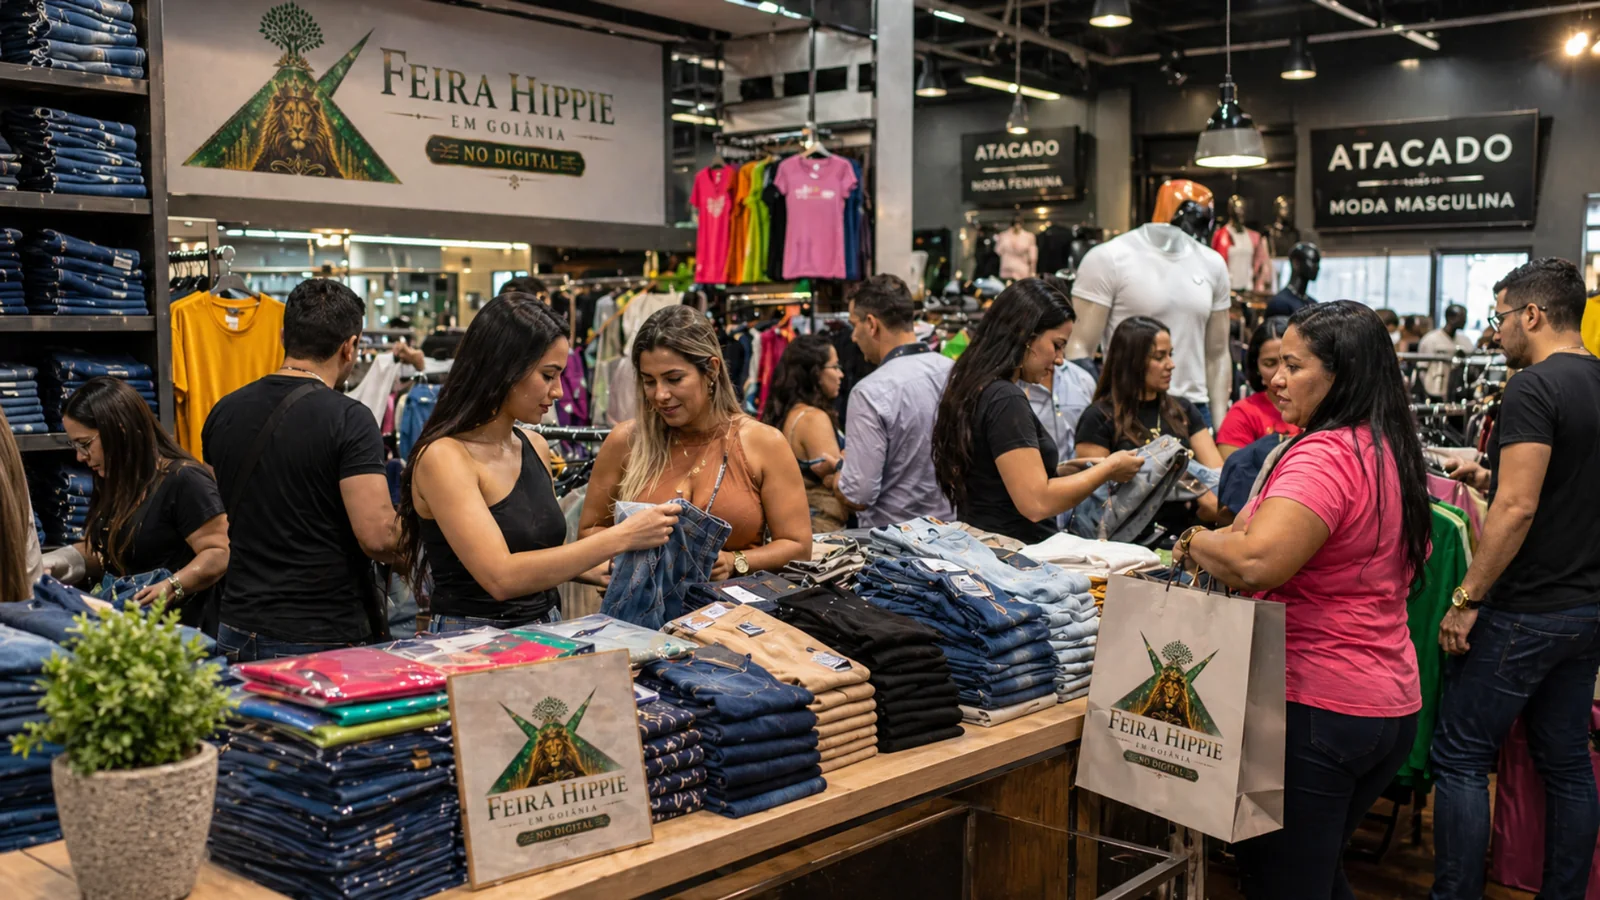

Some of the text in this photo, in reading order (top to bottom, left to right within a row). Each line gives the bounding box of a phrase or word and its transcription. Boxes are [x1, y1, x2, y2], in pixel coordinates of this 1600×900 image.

[380, 47, 616, 126] FEIRA HIPPIE
[451, 114, 566, 142] EM GOIÂNIA
[463, 145, 559, 170] NO DIGITAL
[974, 139, 1060, 162] ATACADO
[1327, 133, 1513, 172] ATACADO
[1329, 191, 1516, 216] MODA MASCULINA
[1107, 708, 1223, 761] FEIRA HIPPIE
[487, 774, 629, 822] FEIRA HIPPIE
[528, 815, 543, 826] EM
[536, 820, 593, 840] NO DIGITAL
